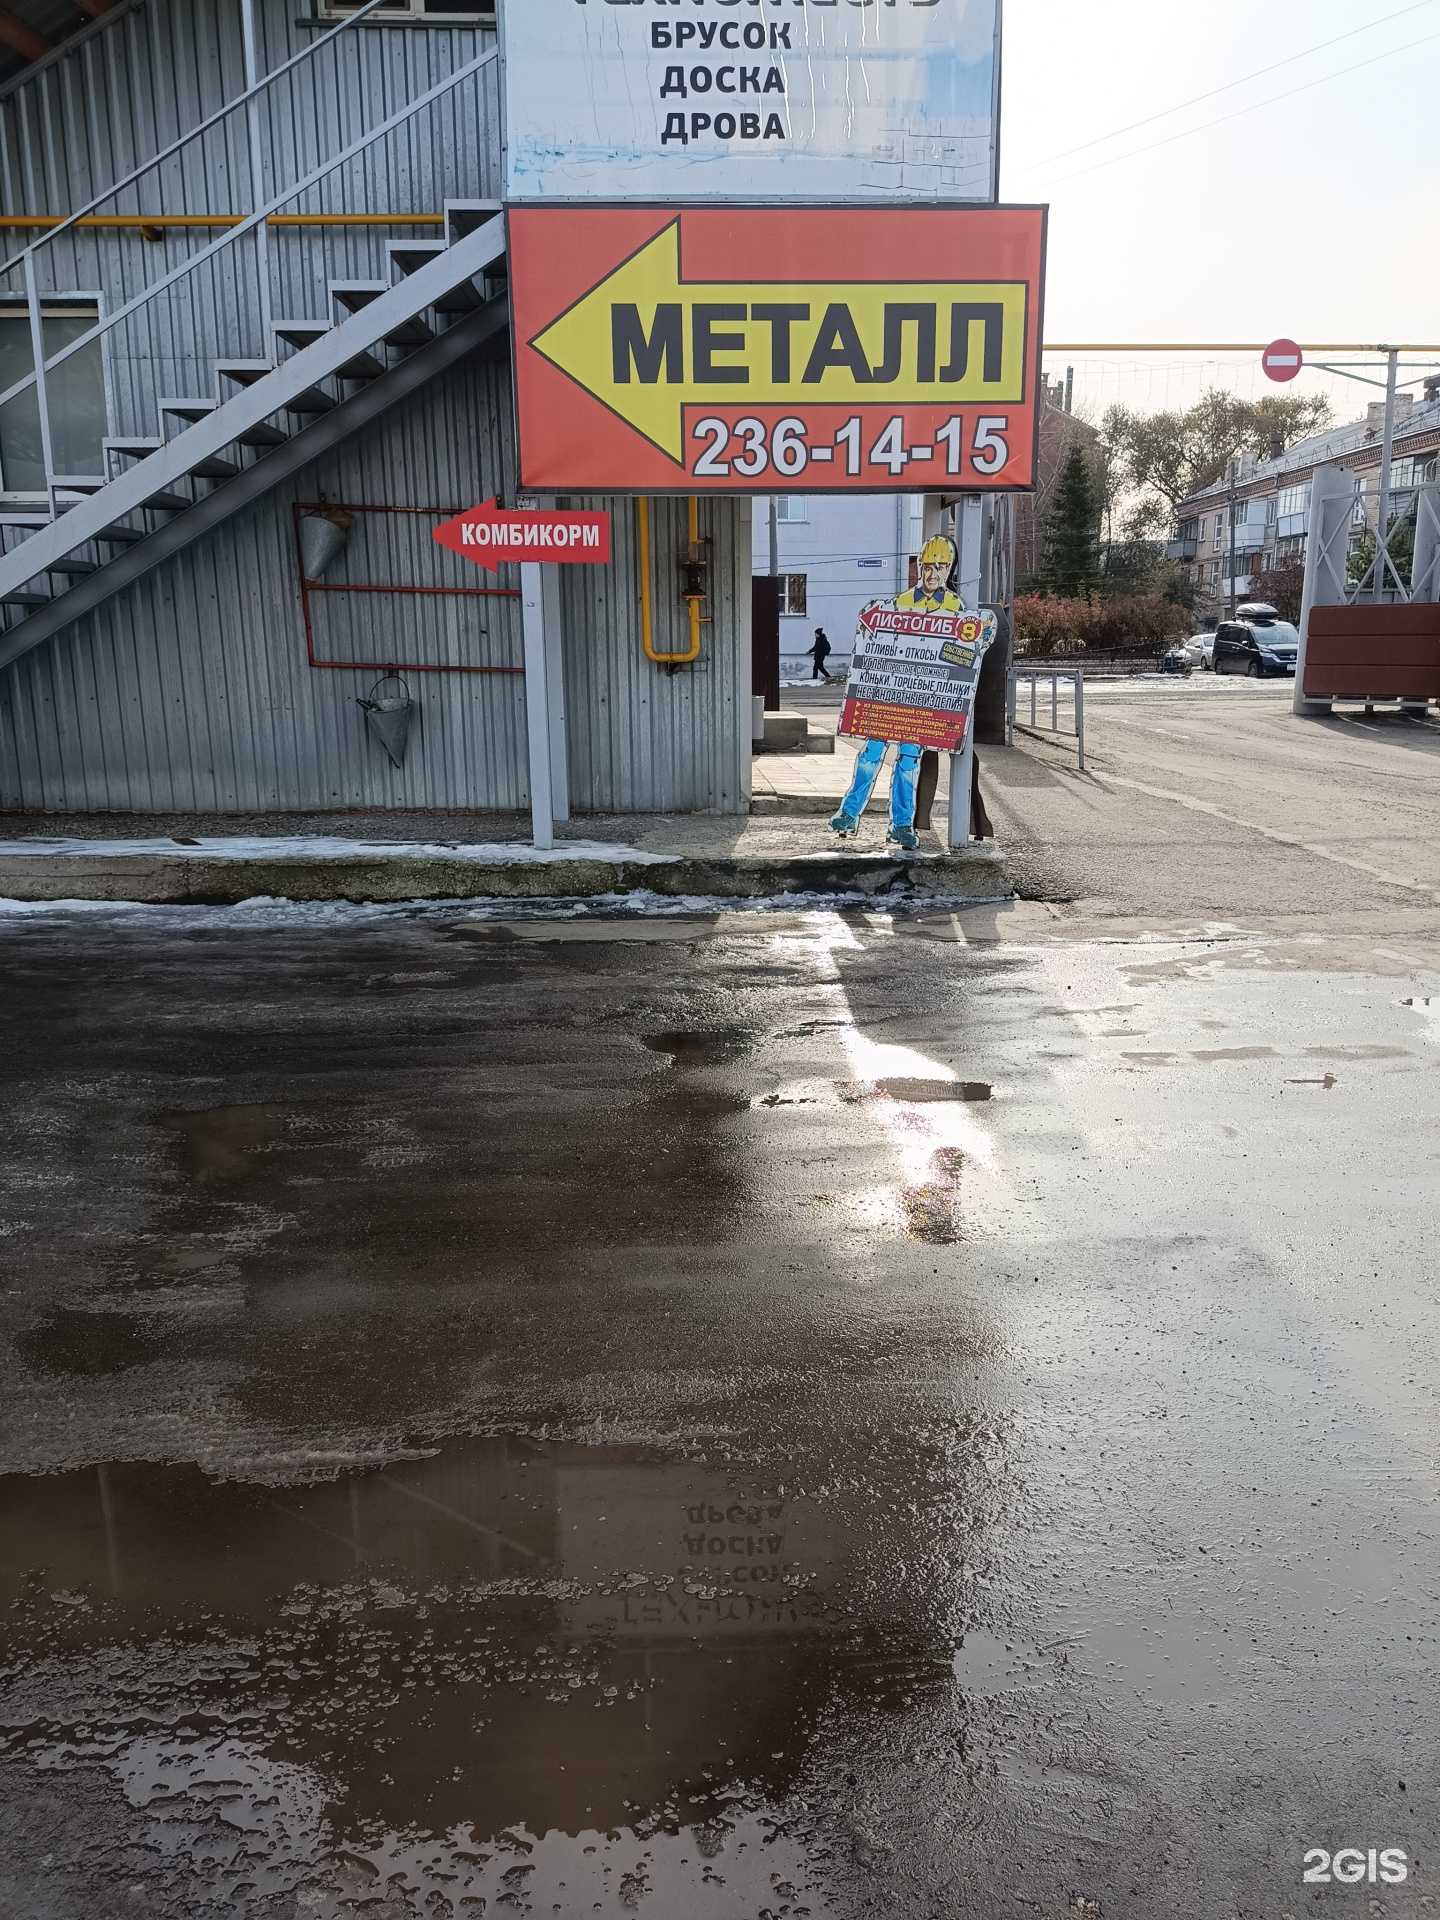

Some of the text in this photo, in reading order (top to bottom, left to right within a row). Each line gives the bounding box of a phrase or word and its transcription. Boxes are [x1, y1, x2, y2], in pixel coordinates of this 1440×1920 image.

[651, 21, 792, 49] БРУСОК
[660, 66, 785, 98] ДОСКА
[661, 112, 785, 144] ДРОВА
[611, 303, 1004, 384] МЕТАЛЛ
[692, 415, 1009, 477] 236-14-15
[461, 522, 600, 549] КОМБИКОРМ
[869, 612, 953, 633] ЛИСТОГИБ
[865, 643, 897, 656] ОТЛИВЫ
[905, 646, 938, 661] ОТКОСЫ
[893, 675, 936, 692] ТОРЦЕВЫЕ
[936, 682, 971, 697] ПЛАНКИ
